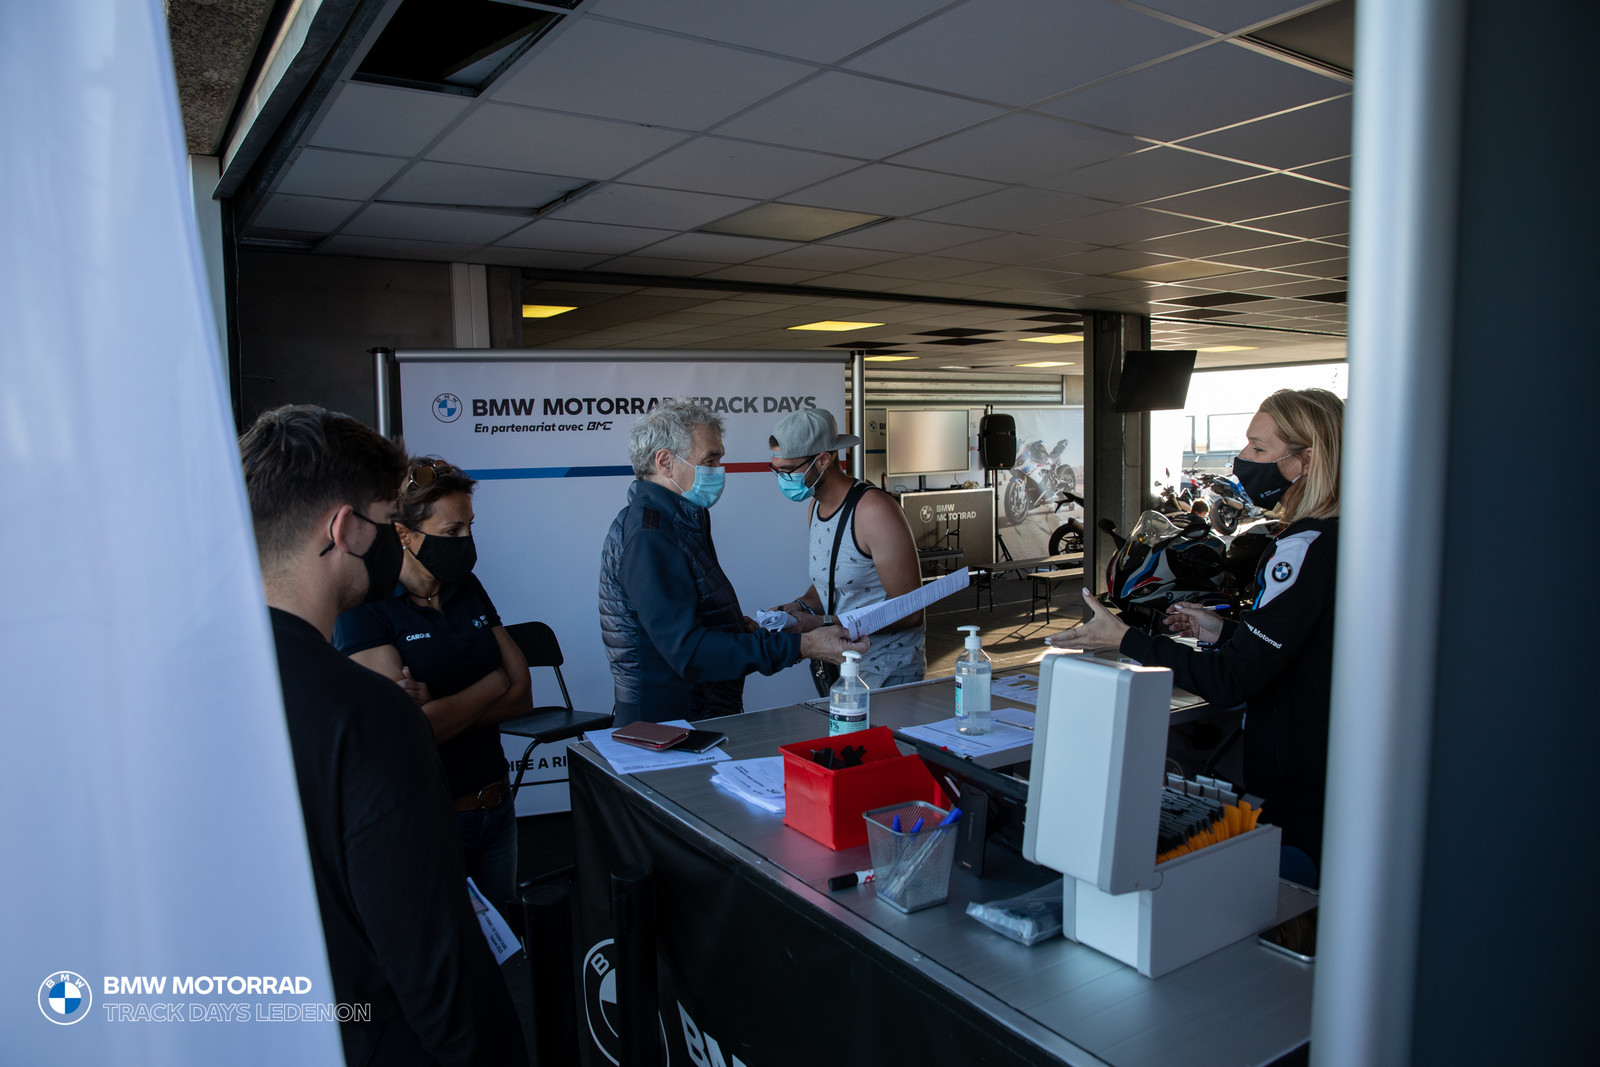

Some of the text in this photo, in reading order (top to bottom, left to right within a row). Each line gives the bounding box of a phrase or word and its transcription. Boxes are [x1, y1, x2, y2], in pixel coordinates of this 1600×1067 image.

[472, 398, 535, 416] BMW
[543, 397, 673, 416] MOTORRA
[763, 396, 816, 413] DAYS
[474, 421, 613, 435] En partenariat avec BMC
[936, 504, 955, 512] BMW
[1252, 628, 1282, 649] Motorrad
[538, 758, 549, 769] A
[552, 756, 566, 768] RI
